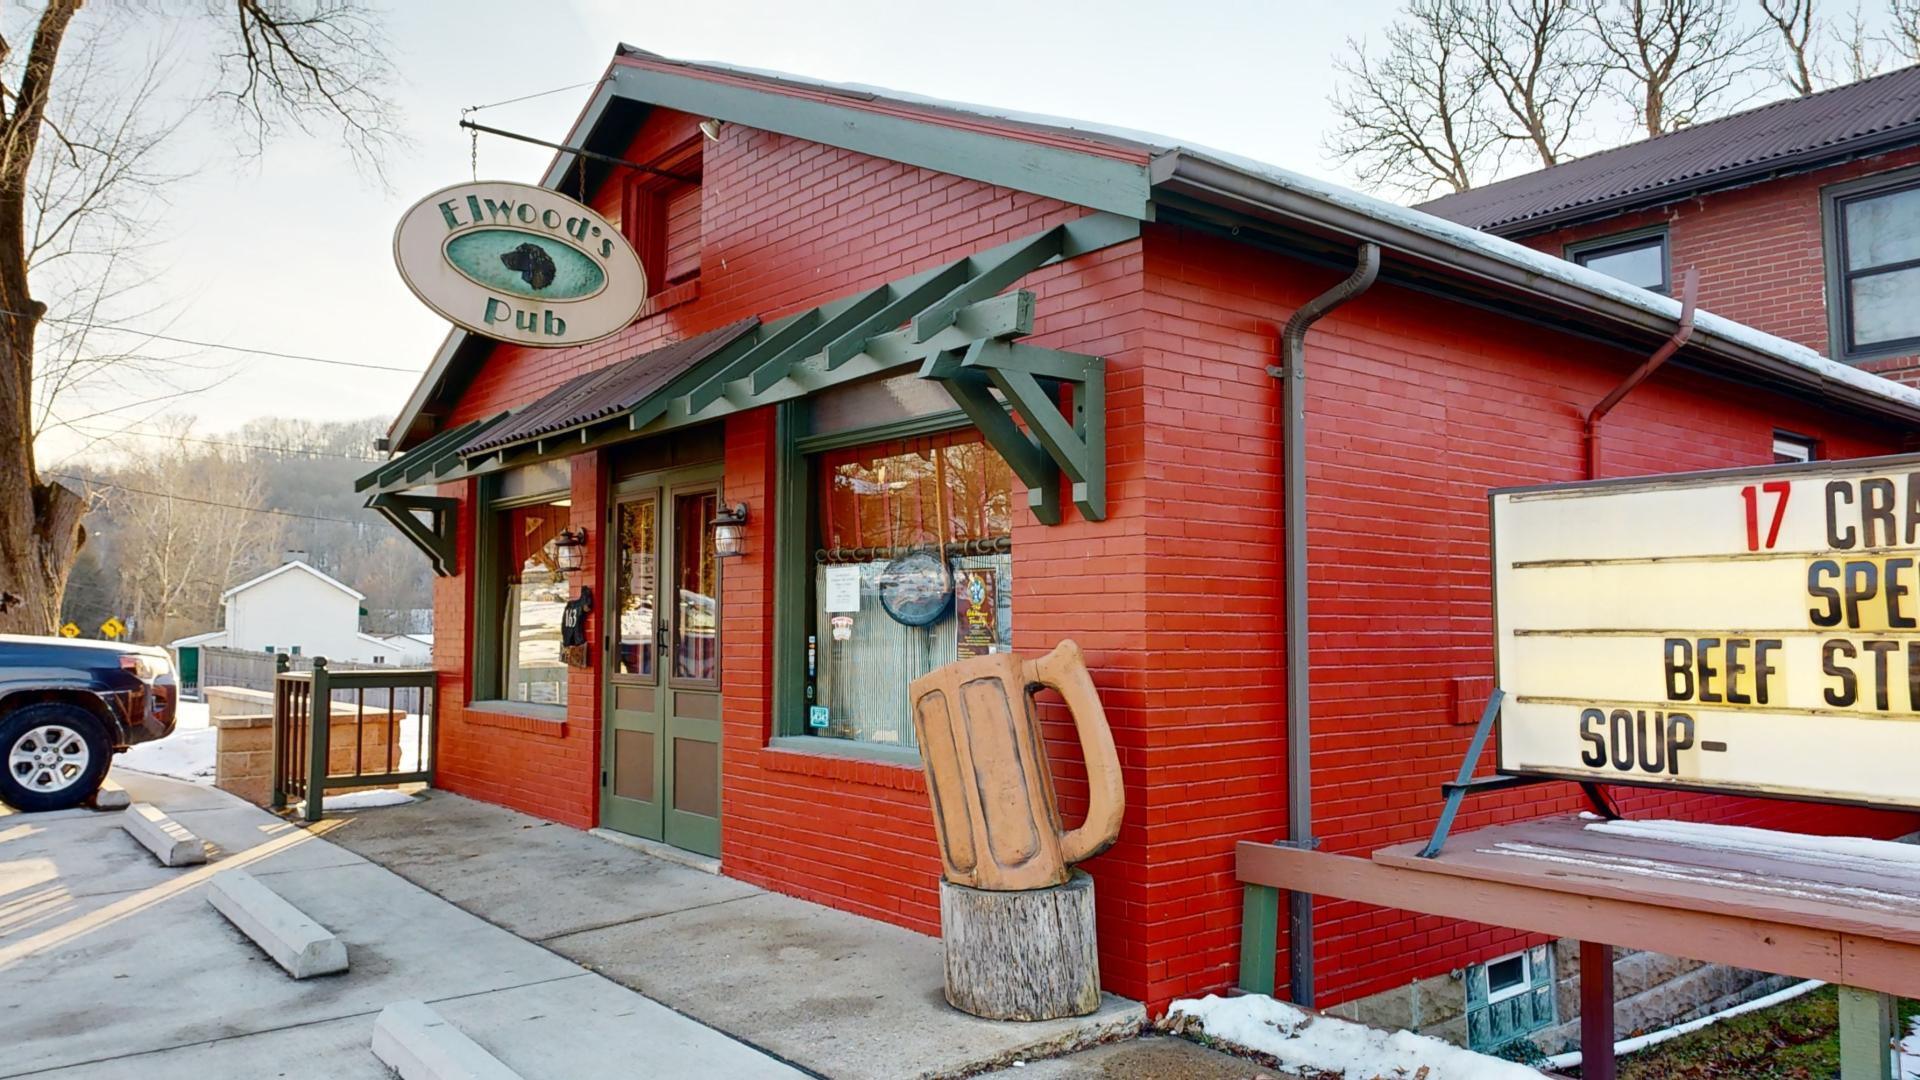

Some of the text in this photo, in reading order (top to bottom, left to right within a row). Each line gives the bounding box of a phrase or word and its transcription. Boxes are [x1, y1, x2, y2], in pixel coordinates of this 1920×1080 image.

[438, 194, 615, 259] Elwood's
[483, 297, 567, 337] Pub
[1740, 480, 1792, 551] 17
[565, 608, 577, 628] 163
[1808, 557, 1920, 629] SPE
[1664, 637, 1783, 705] BEEF
